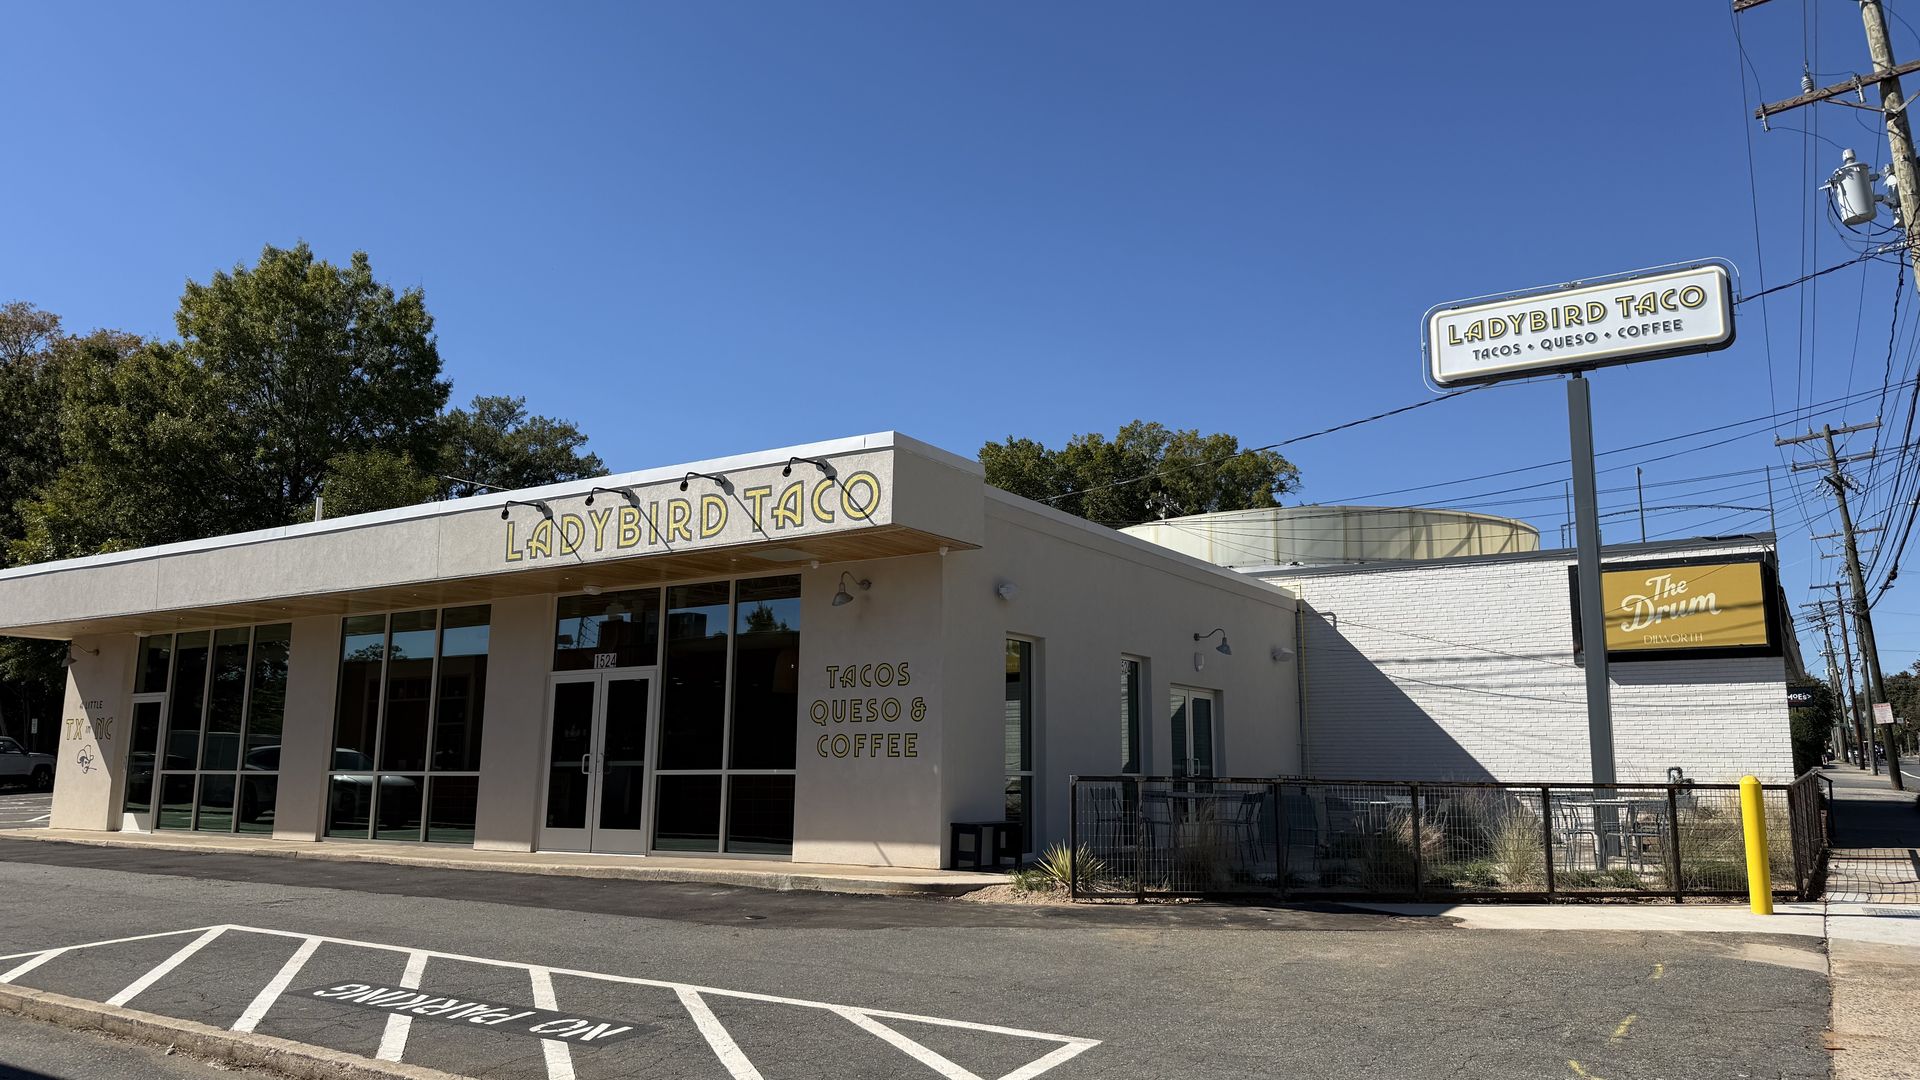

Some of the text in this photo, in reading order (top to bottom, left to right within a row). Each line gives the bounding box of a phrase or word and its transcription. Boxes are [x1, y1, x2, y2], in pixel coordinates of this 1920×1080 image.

[1448, 284, 1705, 346] LADYBIRD TACO
[1472, 318, 1683, 361] TACOS QUESO COFFEE
[505, 470, 882, 563] LADYBIRD TACO
[1645, 573, 1689, 600] The
[1620, 592, 1722, 632] Drum
[595, 653, 616, 668] 1524
[826, 662, 911, 689] TACOS
[85, 700, 103, 709] LITTLE
[810, 696, 927, 726] QUESO &
[66, 718, 84, 740] TX
[95, 716, 113, 740] NC
[816, 733, 918, 758] COFFEE
[313, 983, 634, 1042] NO PARKING
